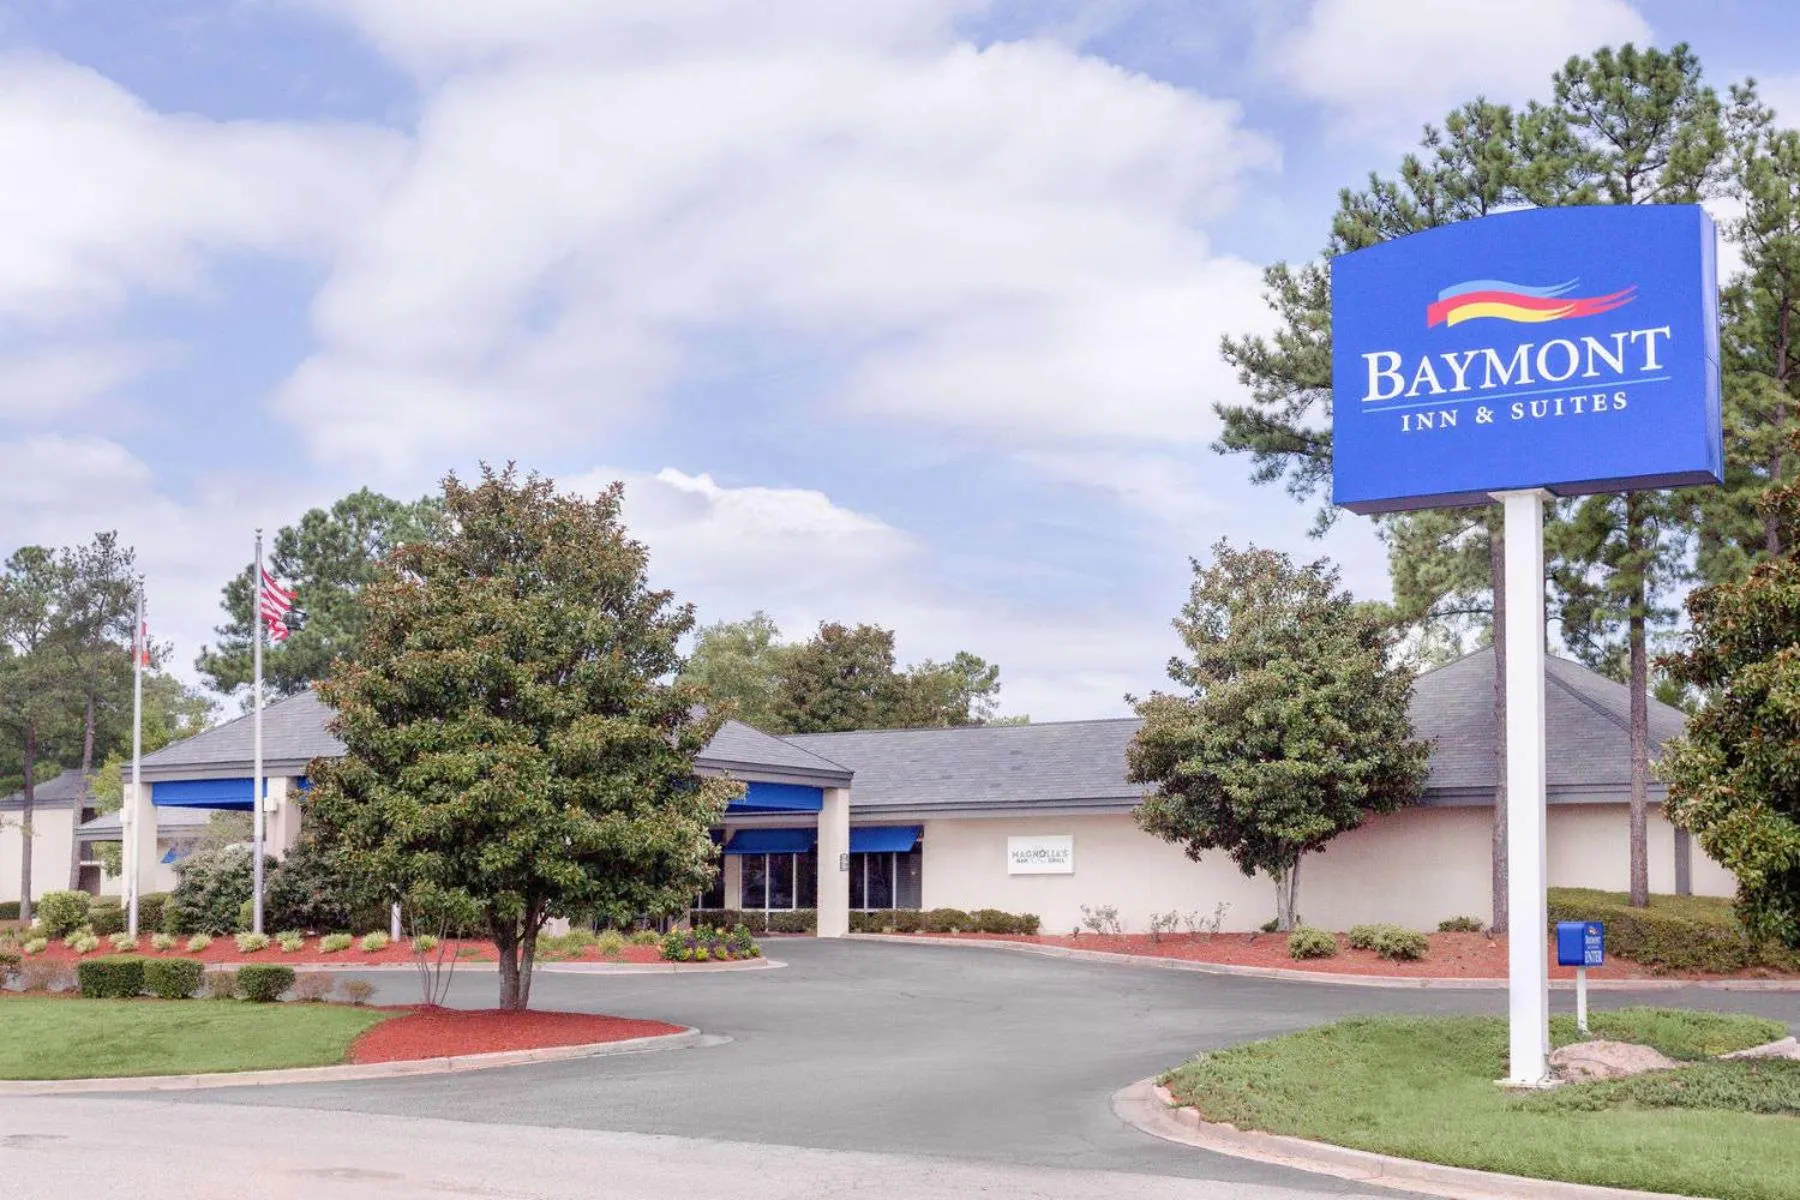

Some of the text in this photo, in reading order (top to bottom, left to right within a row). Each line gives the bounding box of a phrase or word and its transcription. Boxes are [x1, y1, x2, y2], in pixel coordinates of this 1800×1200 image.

[1361, 325, 1671, 402] BAYMONT
[1401, 391, 1628, 432] INN & SUITES
